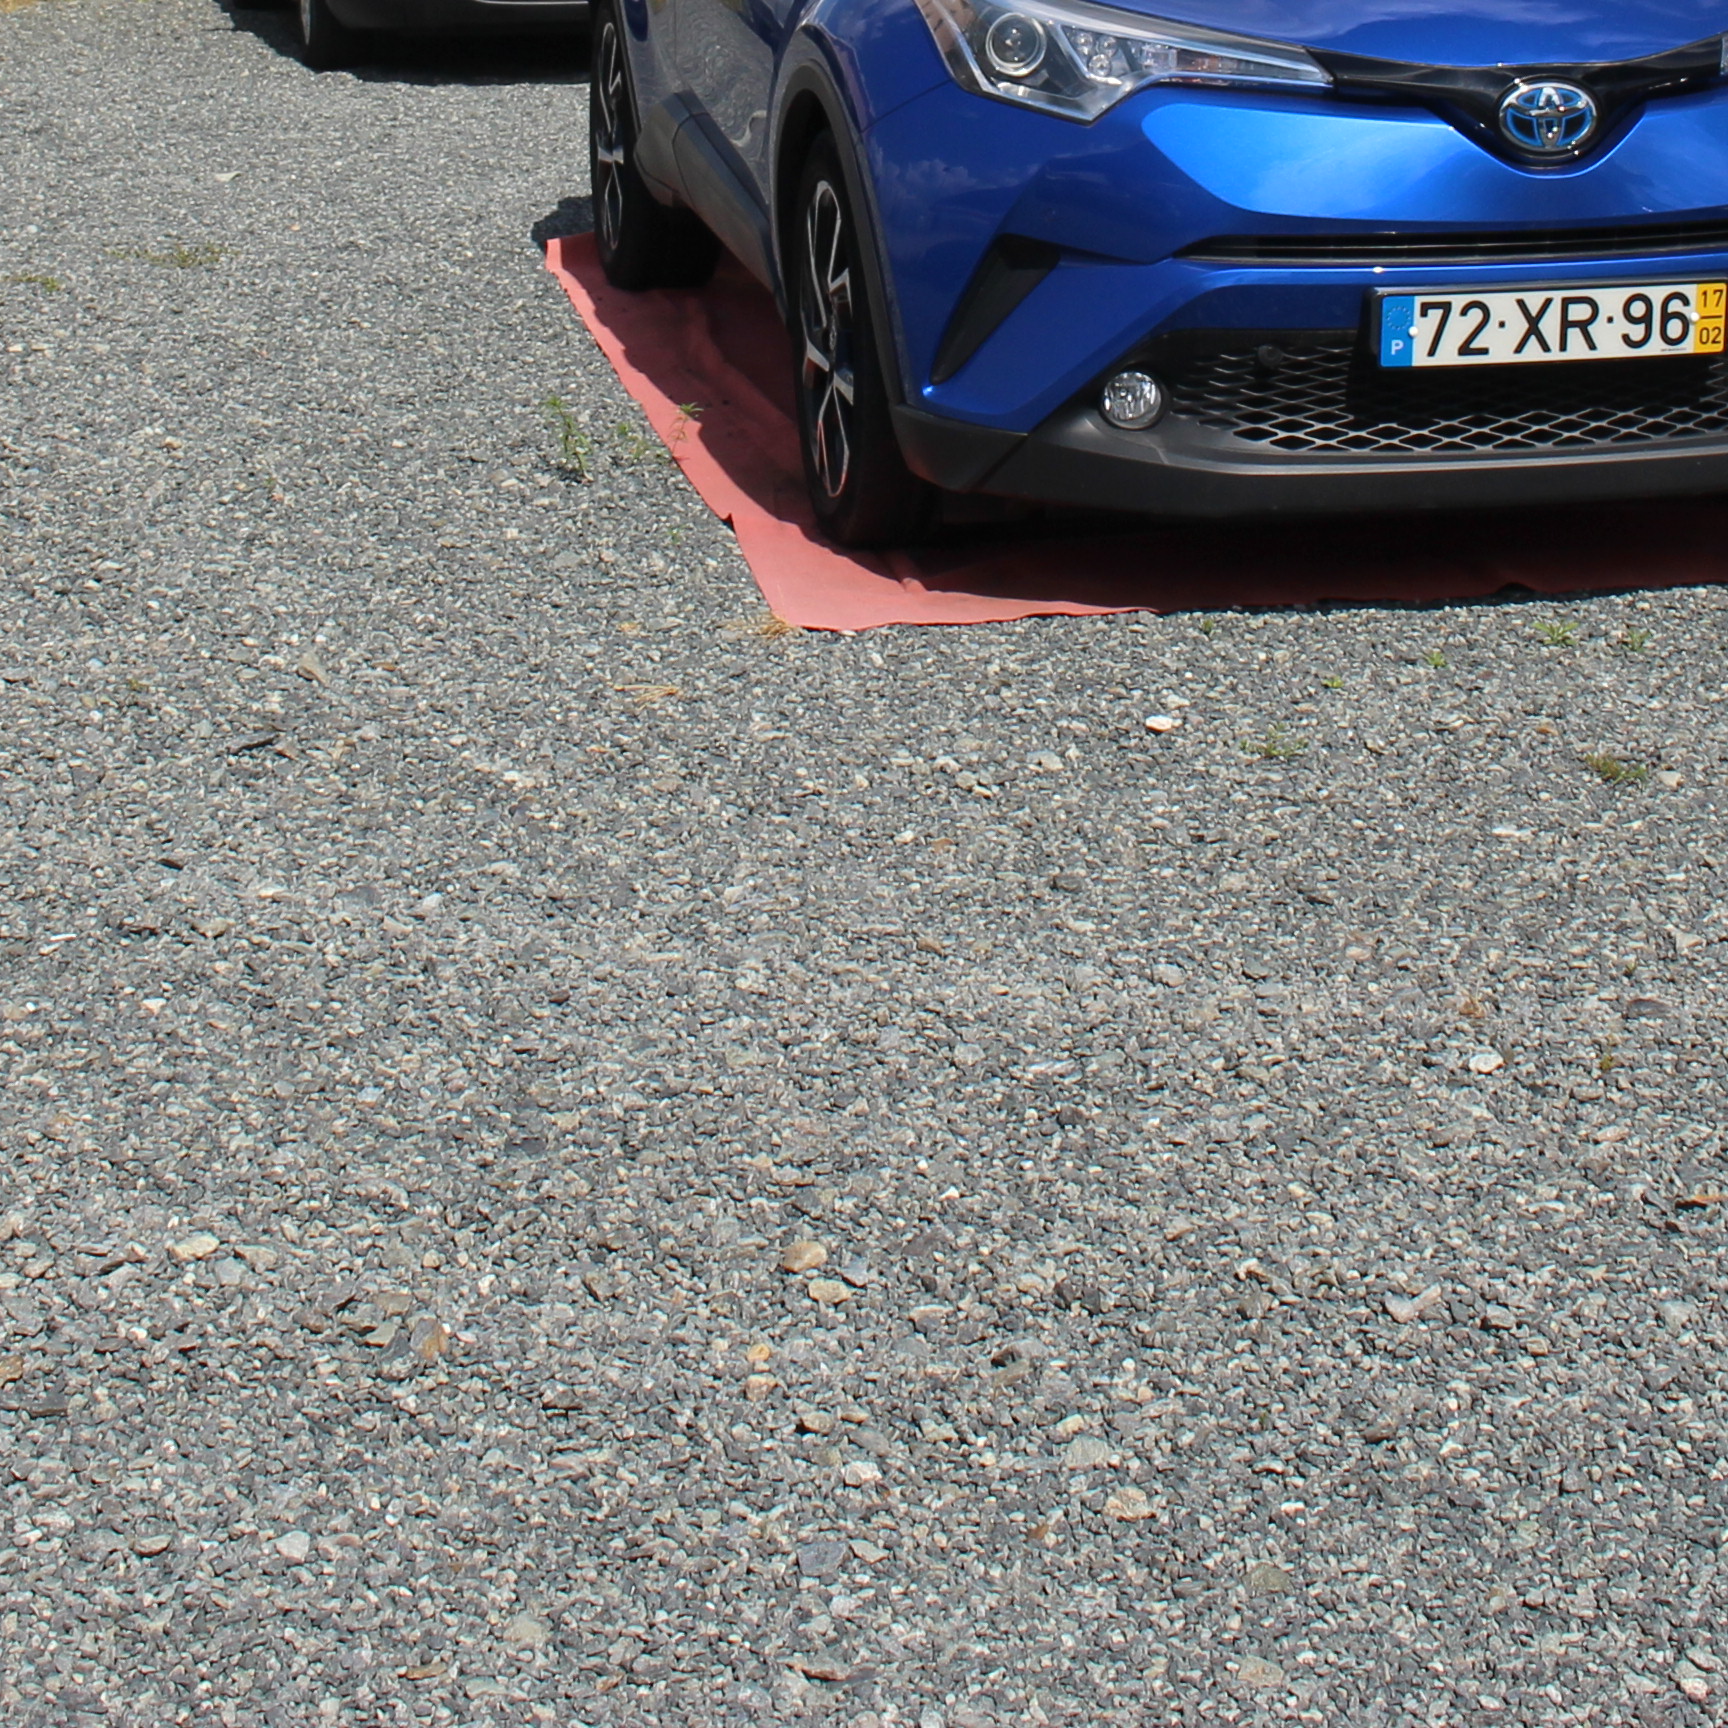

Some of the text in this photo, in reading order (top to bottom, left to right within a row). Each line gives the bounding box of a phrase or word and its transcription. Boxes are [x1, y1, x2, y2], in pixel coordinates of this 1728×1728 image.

[1700, 289, 1724, 308] 17
[1698, 326, 1722, 345] 02
[1390, 339, 1404, 355] P
